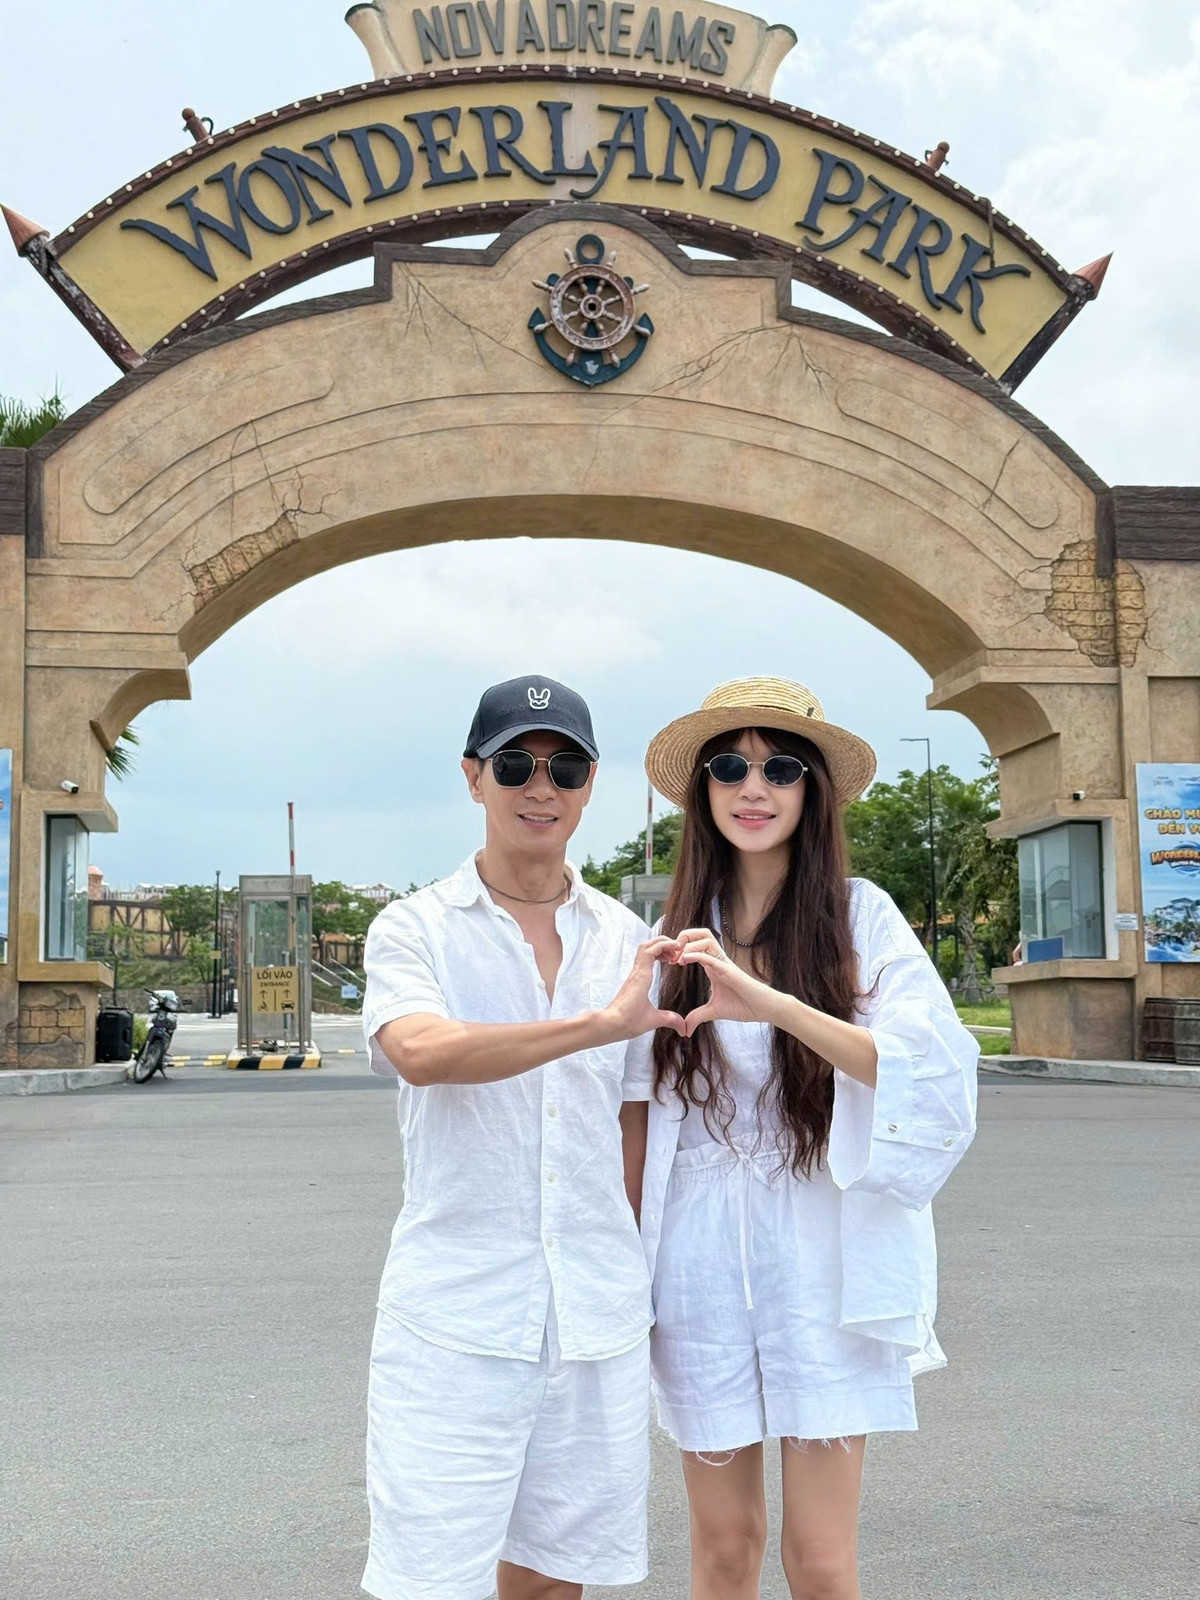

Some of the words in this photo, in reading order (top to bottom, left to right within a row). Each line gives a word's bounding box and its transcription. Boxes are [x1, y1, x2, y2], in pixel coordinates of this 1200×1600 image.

[412, 0, 736, 76] NOVADREAMS
[120, 94, 781, 282] WONDERLAND
[795, 147, 1031, 335] PARK
[1145, 806, 1182, 820] CHÀO
[1158, 820, 1186, 834] ĐẾN
[256, 967, 272, 979] LỐI
[274, 968, 293, 979] VÀO
